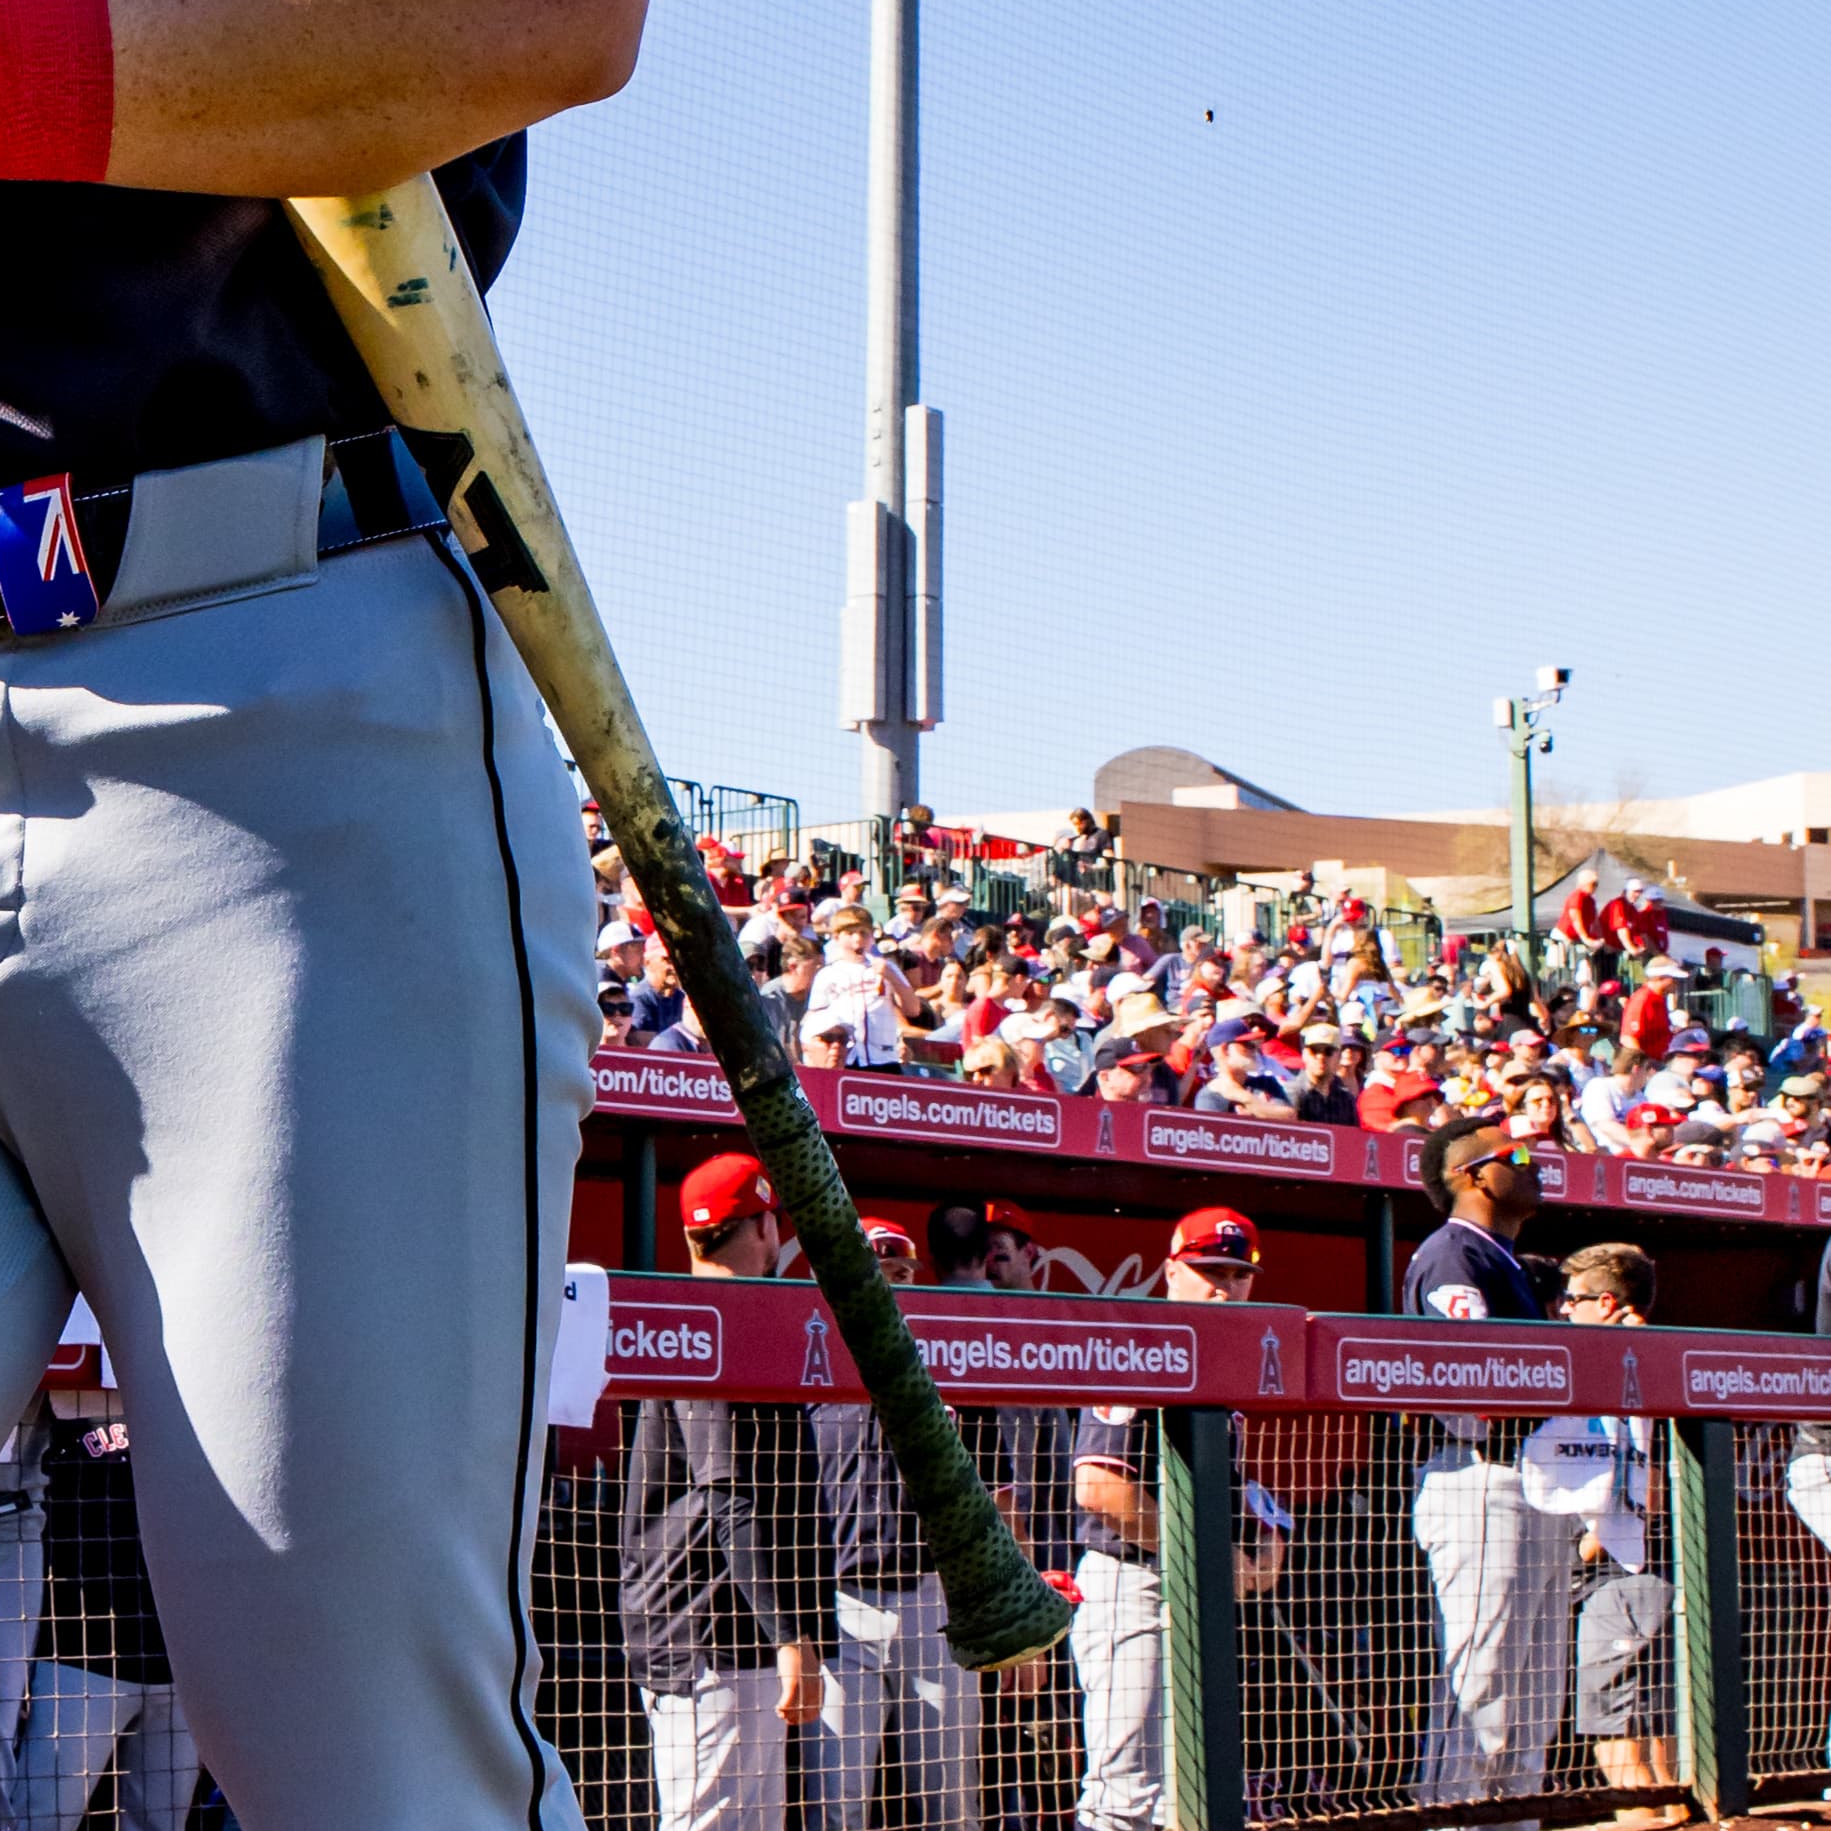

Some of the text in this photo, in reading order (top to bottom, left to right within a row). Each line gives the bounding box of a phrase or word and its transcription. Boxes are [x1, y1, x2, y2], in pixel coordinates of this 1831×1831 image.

[845, 1093, 1056, 1135] angels.com/tickets
[1151, 1125, 1330, 1165] angels.com/tickets
[916, 1334, 1189, 1377] angels.com/tickets
[1345, 1354, 1567, 1393] angels.com/tickets
[1690, 1364, 1831, 1400] angels.com/tic
[82, 1422, 130, 1458] CLE
